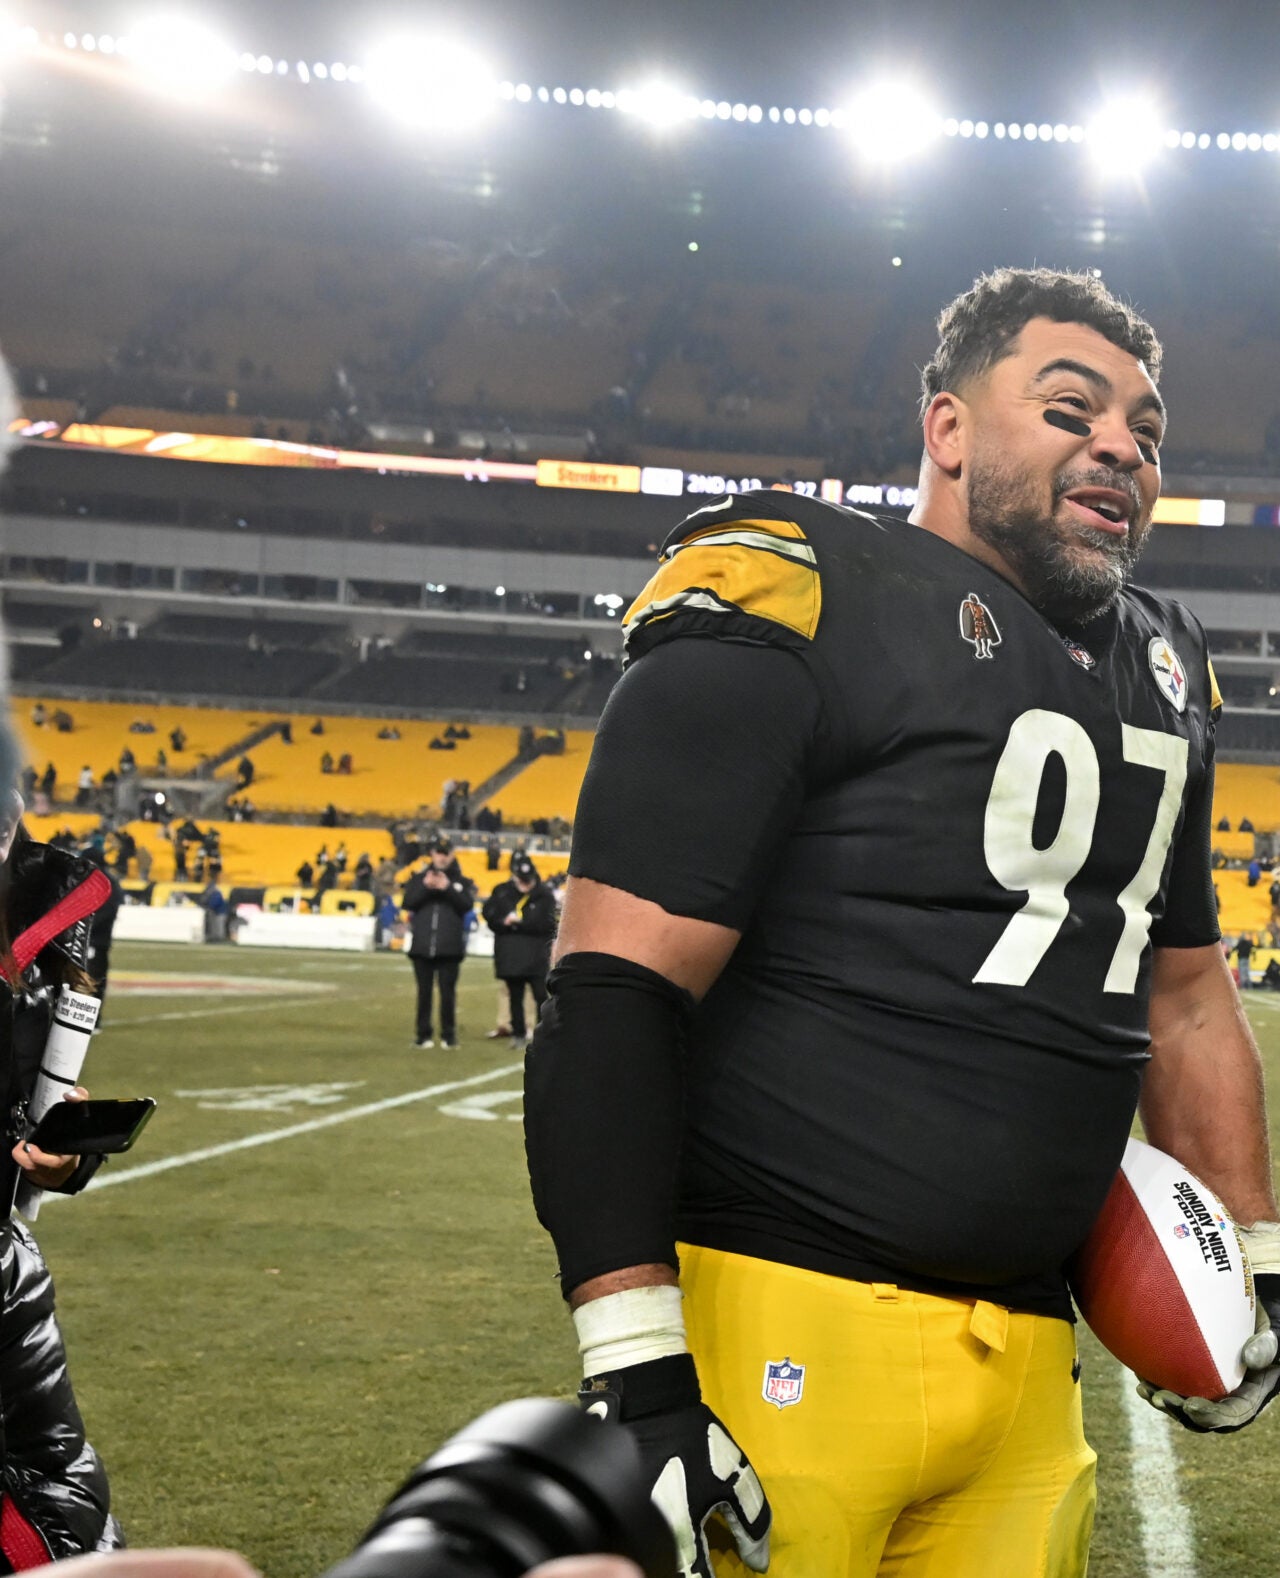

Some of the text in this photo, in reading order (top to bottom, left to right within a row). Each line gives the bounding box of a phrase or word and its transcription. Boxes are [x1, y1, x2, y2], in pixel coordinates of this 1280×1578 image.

[557, 465, 618, 486] Steelers
[687, 474, 726, 495] 2ND
[972, 708, 1189, 995] 97
[1172, 1194, 1212, 1264] FOOTBALL
[1173, 1181, 1216, 1227] SUNDAY
[1205, 1230, 1232, 1272] NIGHT
[768, 1378, 798, 1400] NFL
